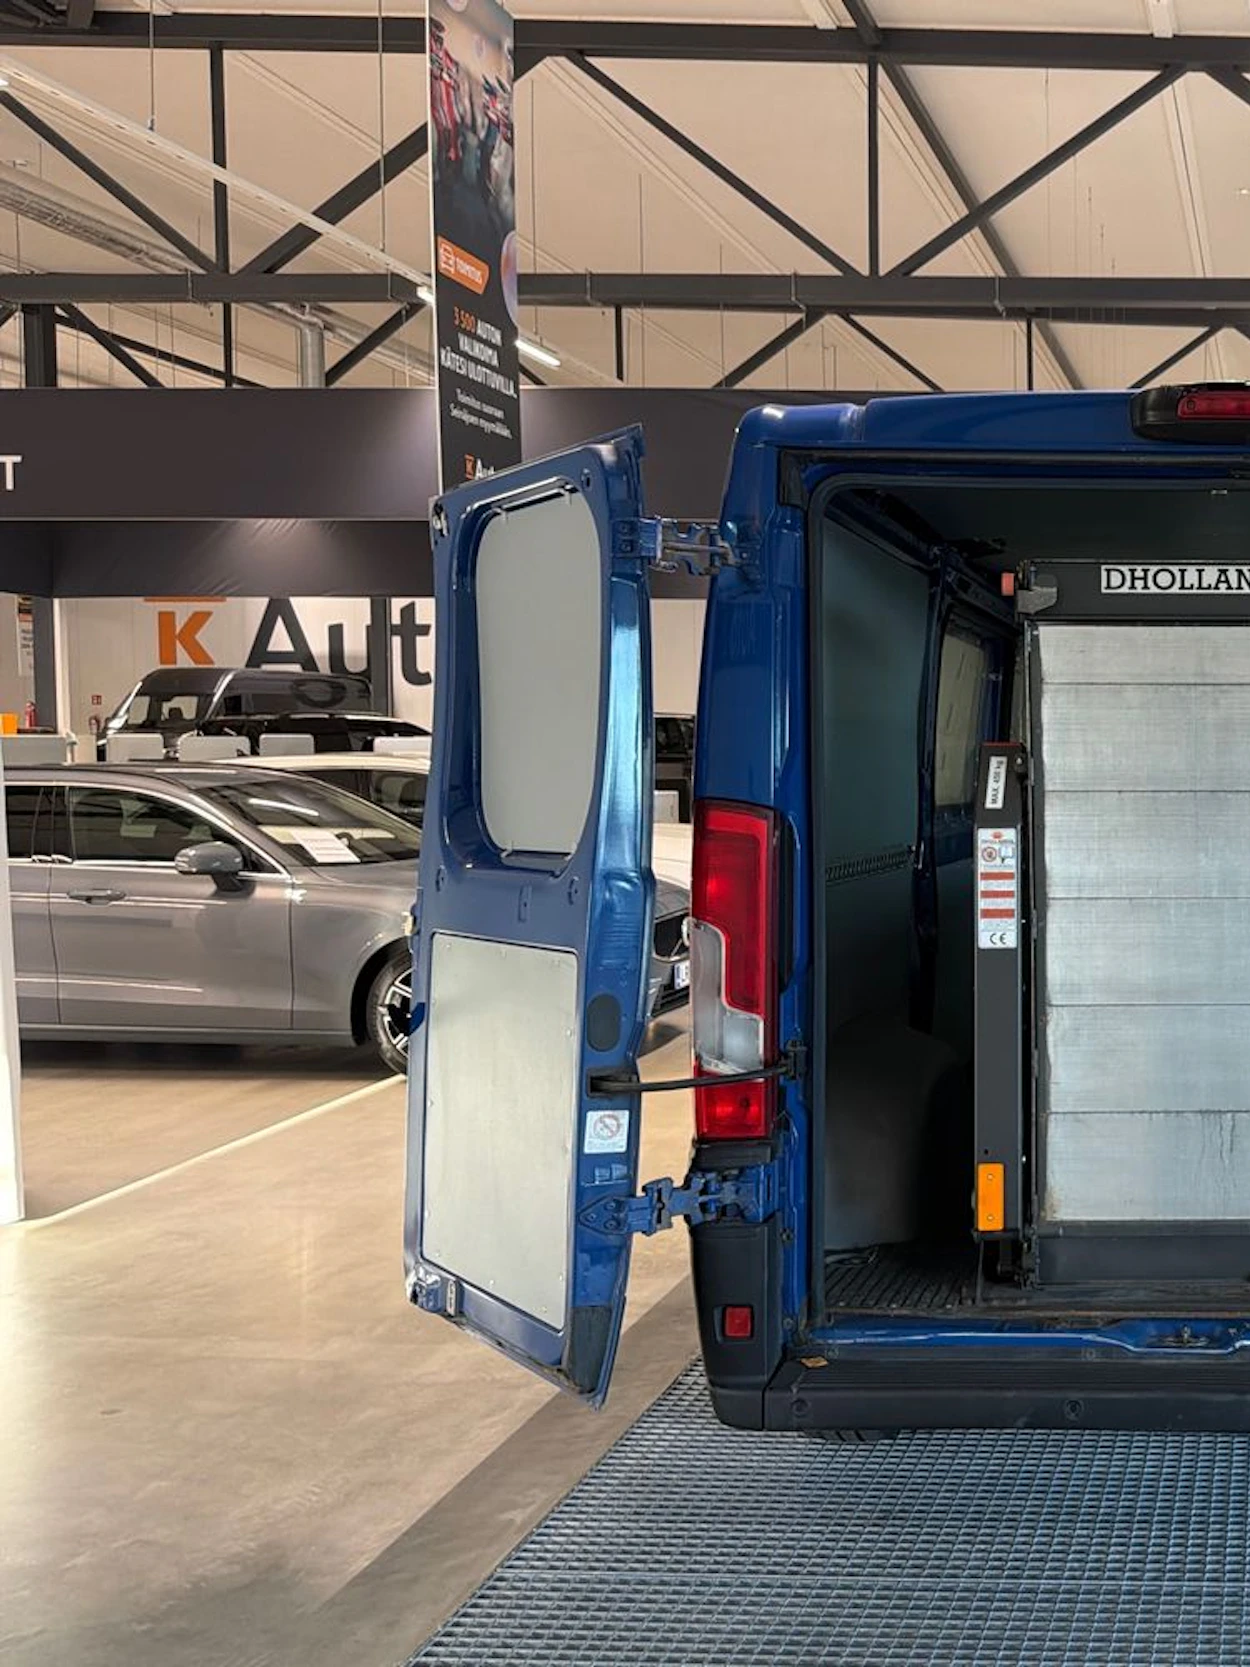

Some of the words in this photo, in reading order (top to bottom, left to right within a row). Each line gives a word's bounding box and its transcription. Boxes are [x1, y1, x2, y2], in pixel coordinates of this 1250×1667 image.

[475, 458, 495, 480] Aut
[158, 611, 215, 666] K
[245, 597, 432, 685] Aut
